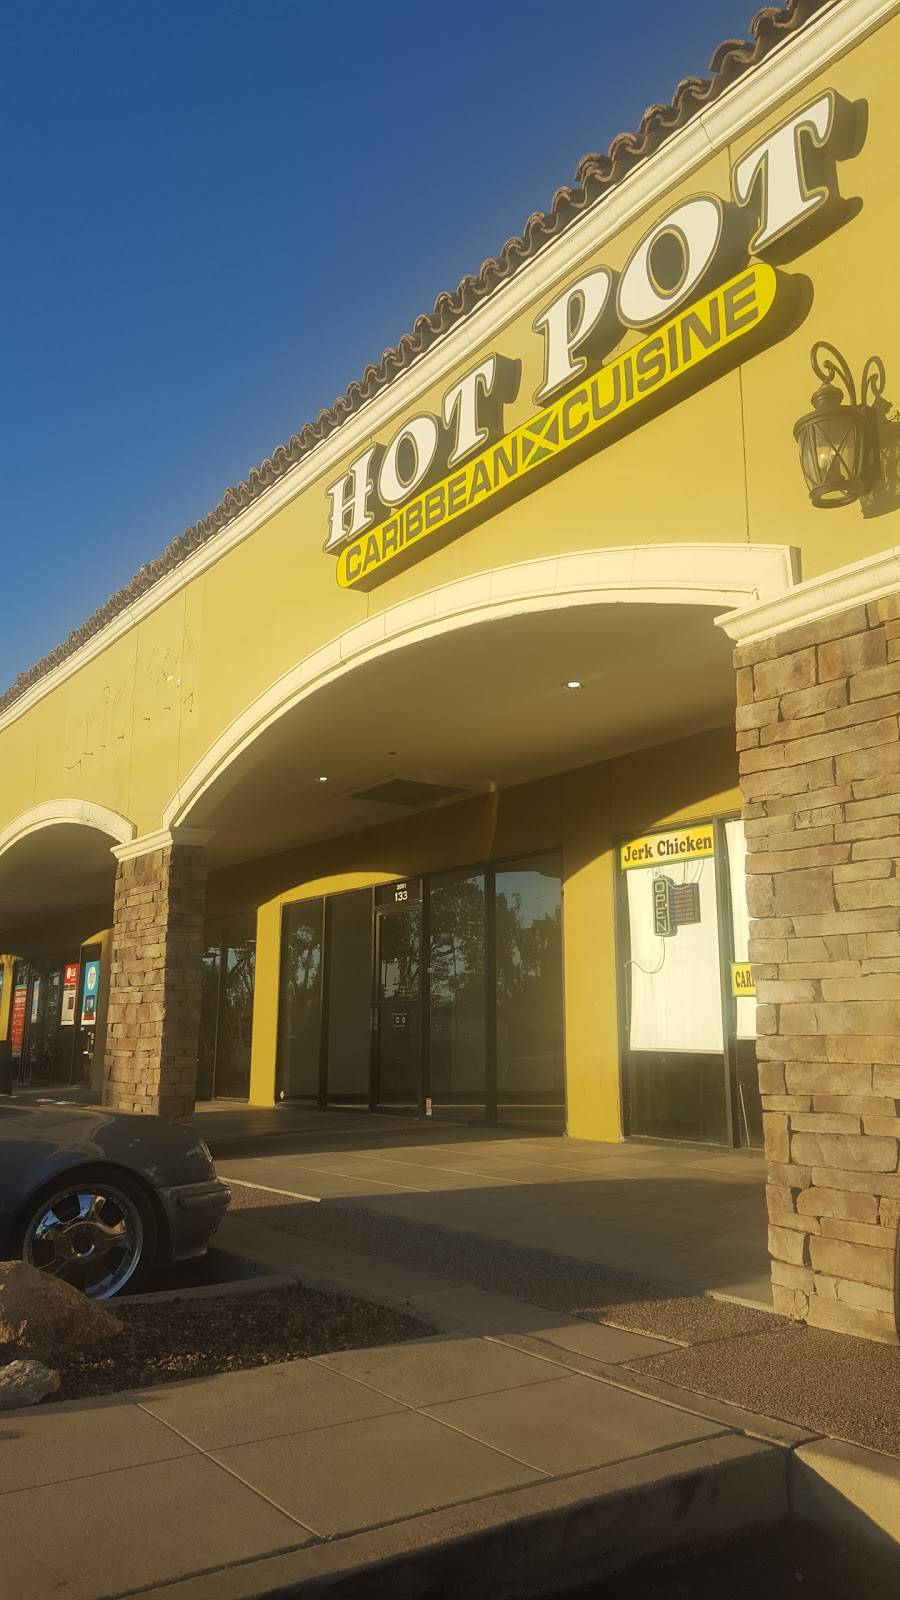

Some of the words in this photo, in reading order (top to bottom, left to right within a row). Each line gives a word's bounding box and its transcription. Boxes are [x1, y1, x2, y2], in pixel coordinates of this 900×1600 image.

[324, 354, 496, 553] HOT
[533, 89, 834, 403] POT
[345, 438, 519, 582] CARIBBEAN
[560, 273, 759, 440] CUISINE
[624, 843, 654, 863] Jerk
[657, 836, 712, 856] Chicken
[394, 890, 408, 902] 133
[655, 882, 667, 932] OPEN
